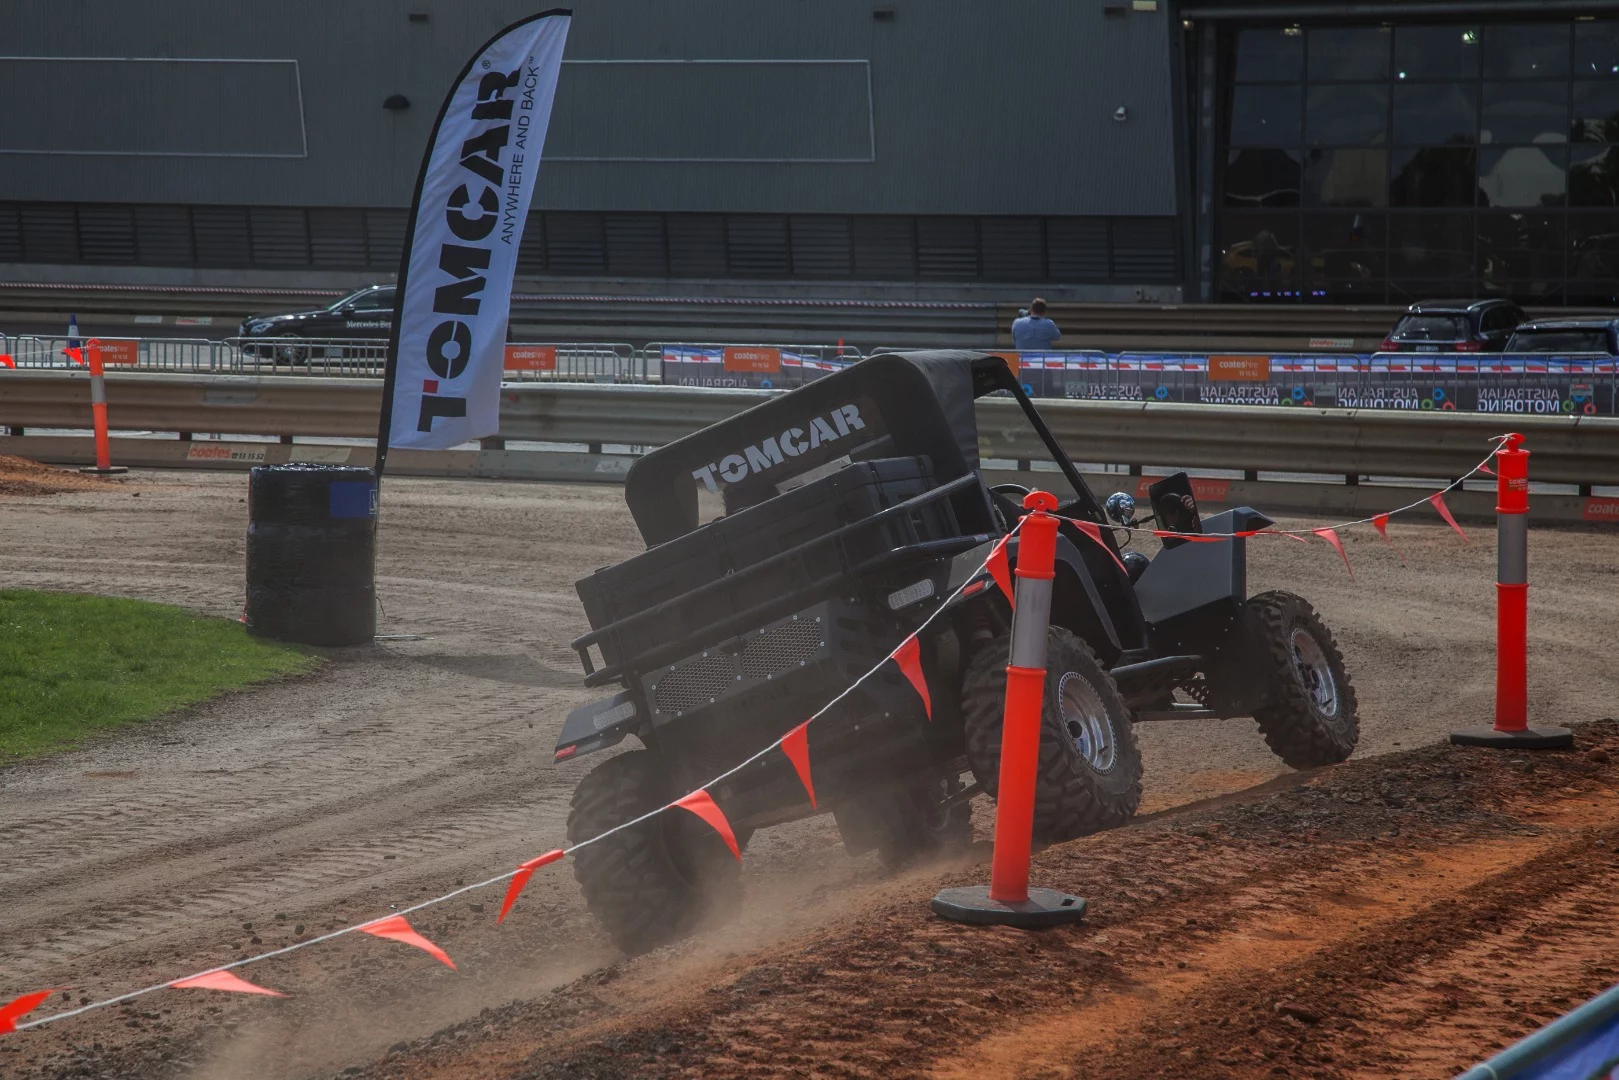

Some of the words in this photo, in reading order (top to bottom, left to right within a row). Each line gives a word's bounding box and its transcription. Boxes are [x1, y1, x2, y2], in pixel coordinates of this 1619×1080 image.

[501, 153, 525, 245] ANYWHERE
[516, 115, 530, 150] AND
[189, 446, 231, 459] coates
[692, 404, 866, 493] TOMCAR
